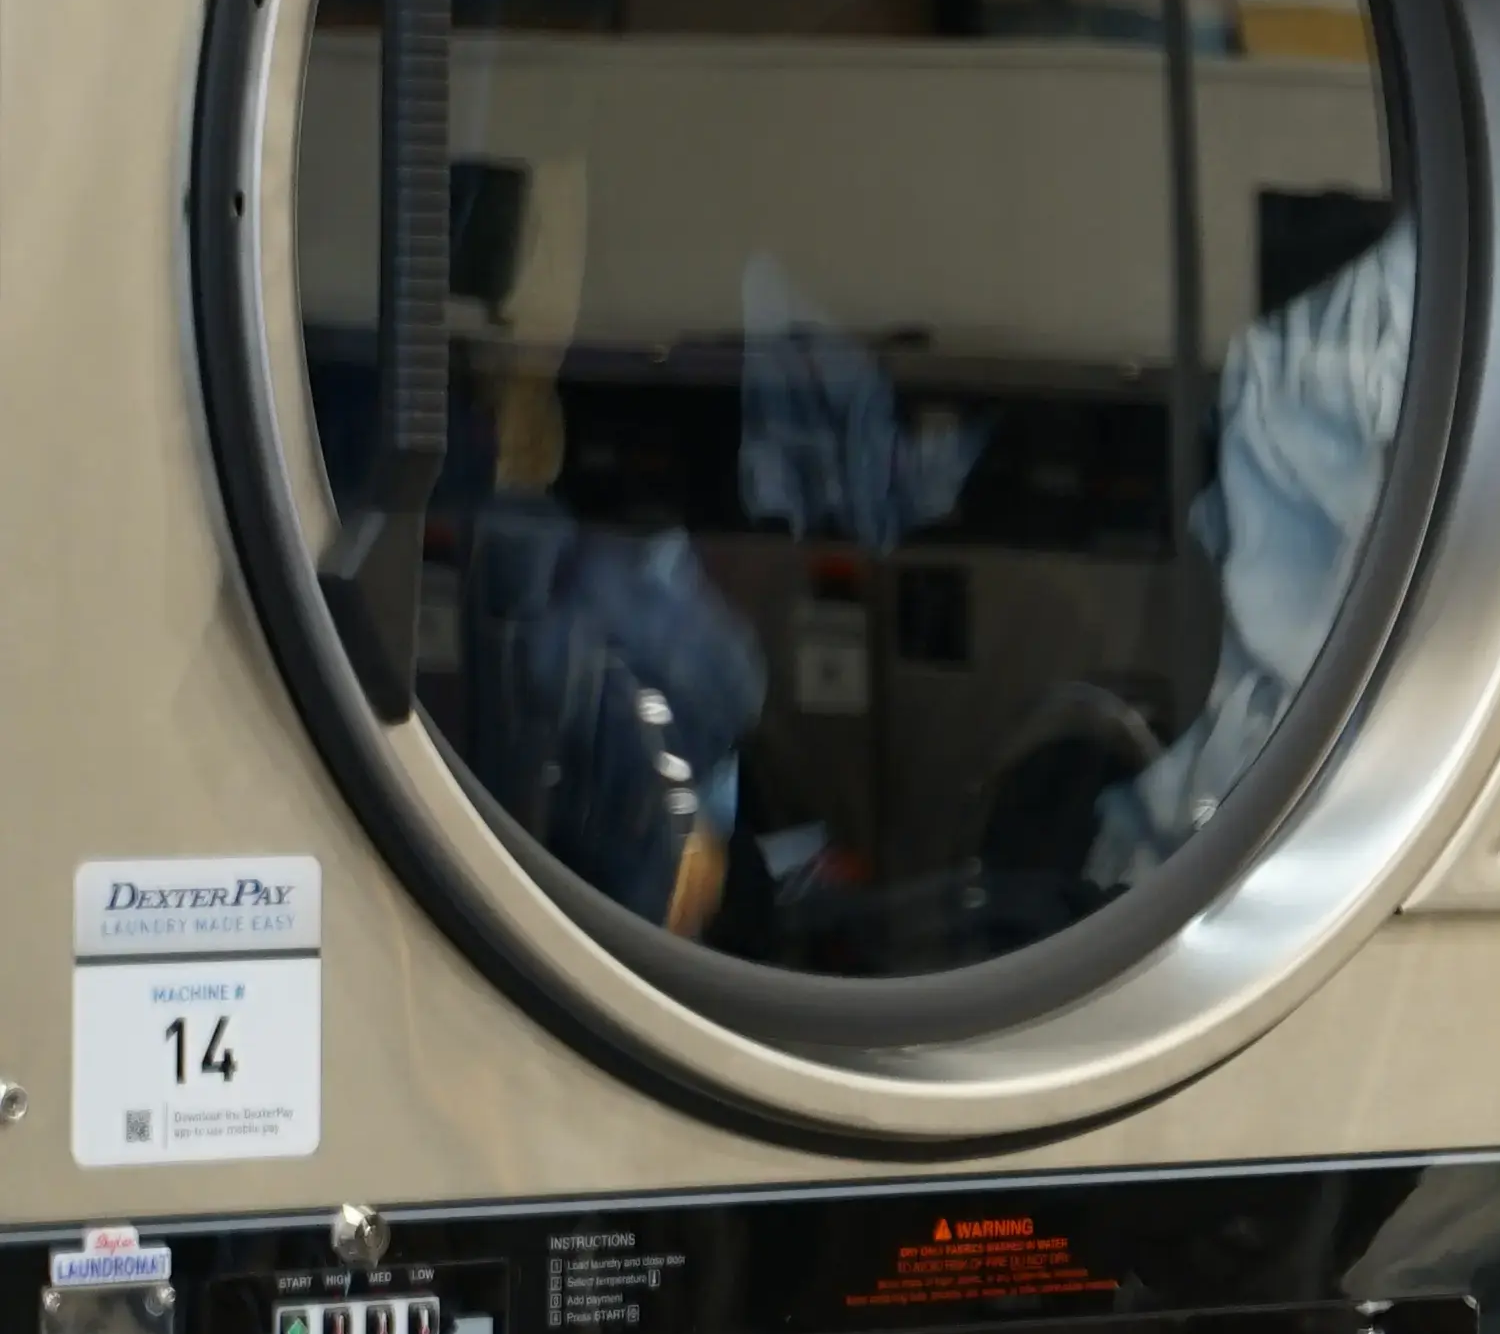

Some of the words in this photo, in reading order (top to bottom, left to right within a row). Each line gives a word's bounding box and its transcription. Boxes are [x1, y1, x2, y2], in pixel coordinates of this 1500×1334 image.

[101, 918, 187, 937] LAUNDRY
[196, 916, 244, 934] MADE
[252, 915, 295, 932] EASY
[153, 985, 230, 1003] MACHINE
[234, 984, 245, 1000] #
[165, 1015, 237, 1085] 14
[956, 1218, 1033, 1239] WARNING
[550, 1233, 636, 1250] INSTRUCTIONS
[57, 1254, 167, 1280] LAUNDROMAT
[567, 1260, 589, 1270] Load
[624, 1256, 640, 1267] and
[279, 1276, 313, 1289] START
[326, 1274, 351, 1285] HIGH
[369, 1272, 392, 1282] MED
[411, 1269, 435, 1280] LOW
